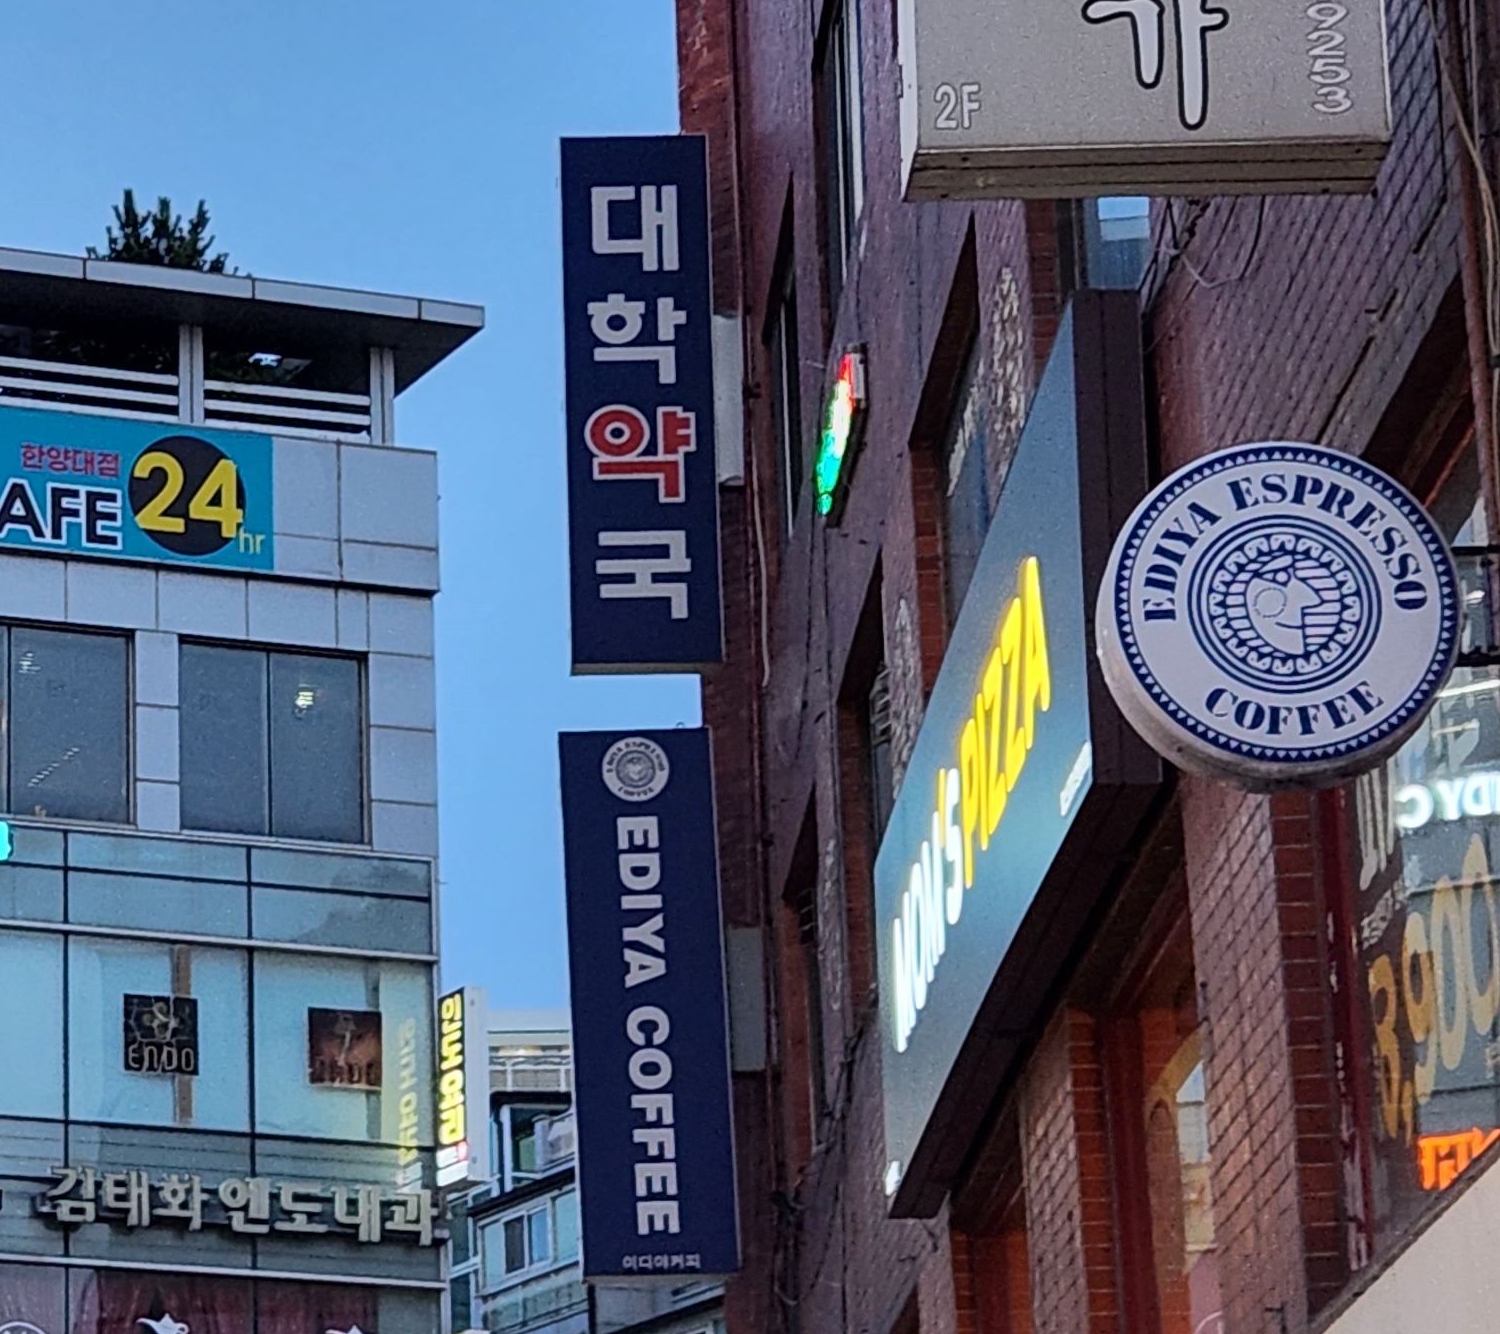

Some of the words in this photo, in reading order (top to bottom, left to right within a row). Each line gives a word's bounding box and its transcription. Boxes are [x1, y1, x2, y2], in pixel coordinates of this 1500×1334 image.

[932, 81, 983, 130] 2F
[20, 441, 122, 480] 한양대점
[584, 184, 697, 620] 대학약국
[132, 450, 247, 538] 24
[236, 525, 267, 556] hr
[1144, 498, 1223, 623] EDIYA
[1227, 475, 1429, 612] ESPRESSO
[960, 555, 1051, 889] PIZZA
[1205, 678, 1386, 737] COFFEE
[615, 815, 667, 989] EDIYA
[626, 1005, 681, 1236] COFFEE
